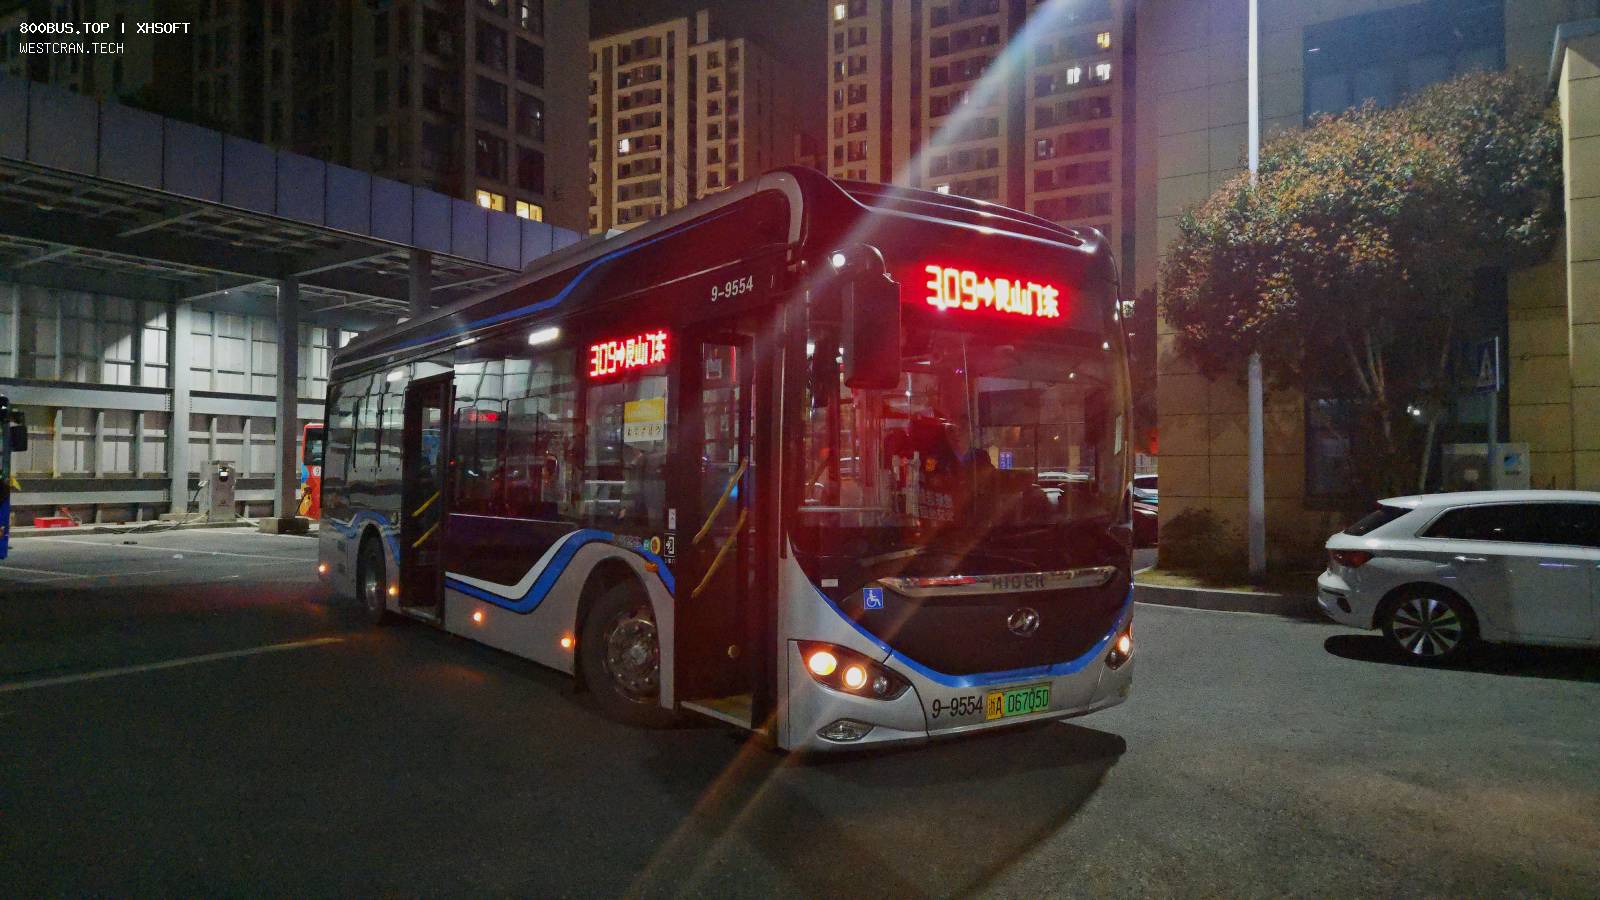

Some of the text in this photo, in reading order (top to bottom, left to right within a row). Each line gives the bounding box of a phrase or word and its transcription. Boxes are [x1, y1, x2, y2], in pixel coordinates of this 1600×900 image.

[711, 275, 753, 301] 9-9554
[925, 265, 978, 310] 309
[590, 341, 617, 377] 309
[931, 695, 983, 718] 9-9554
